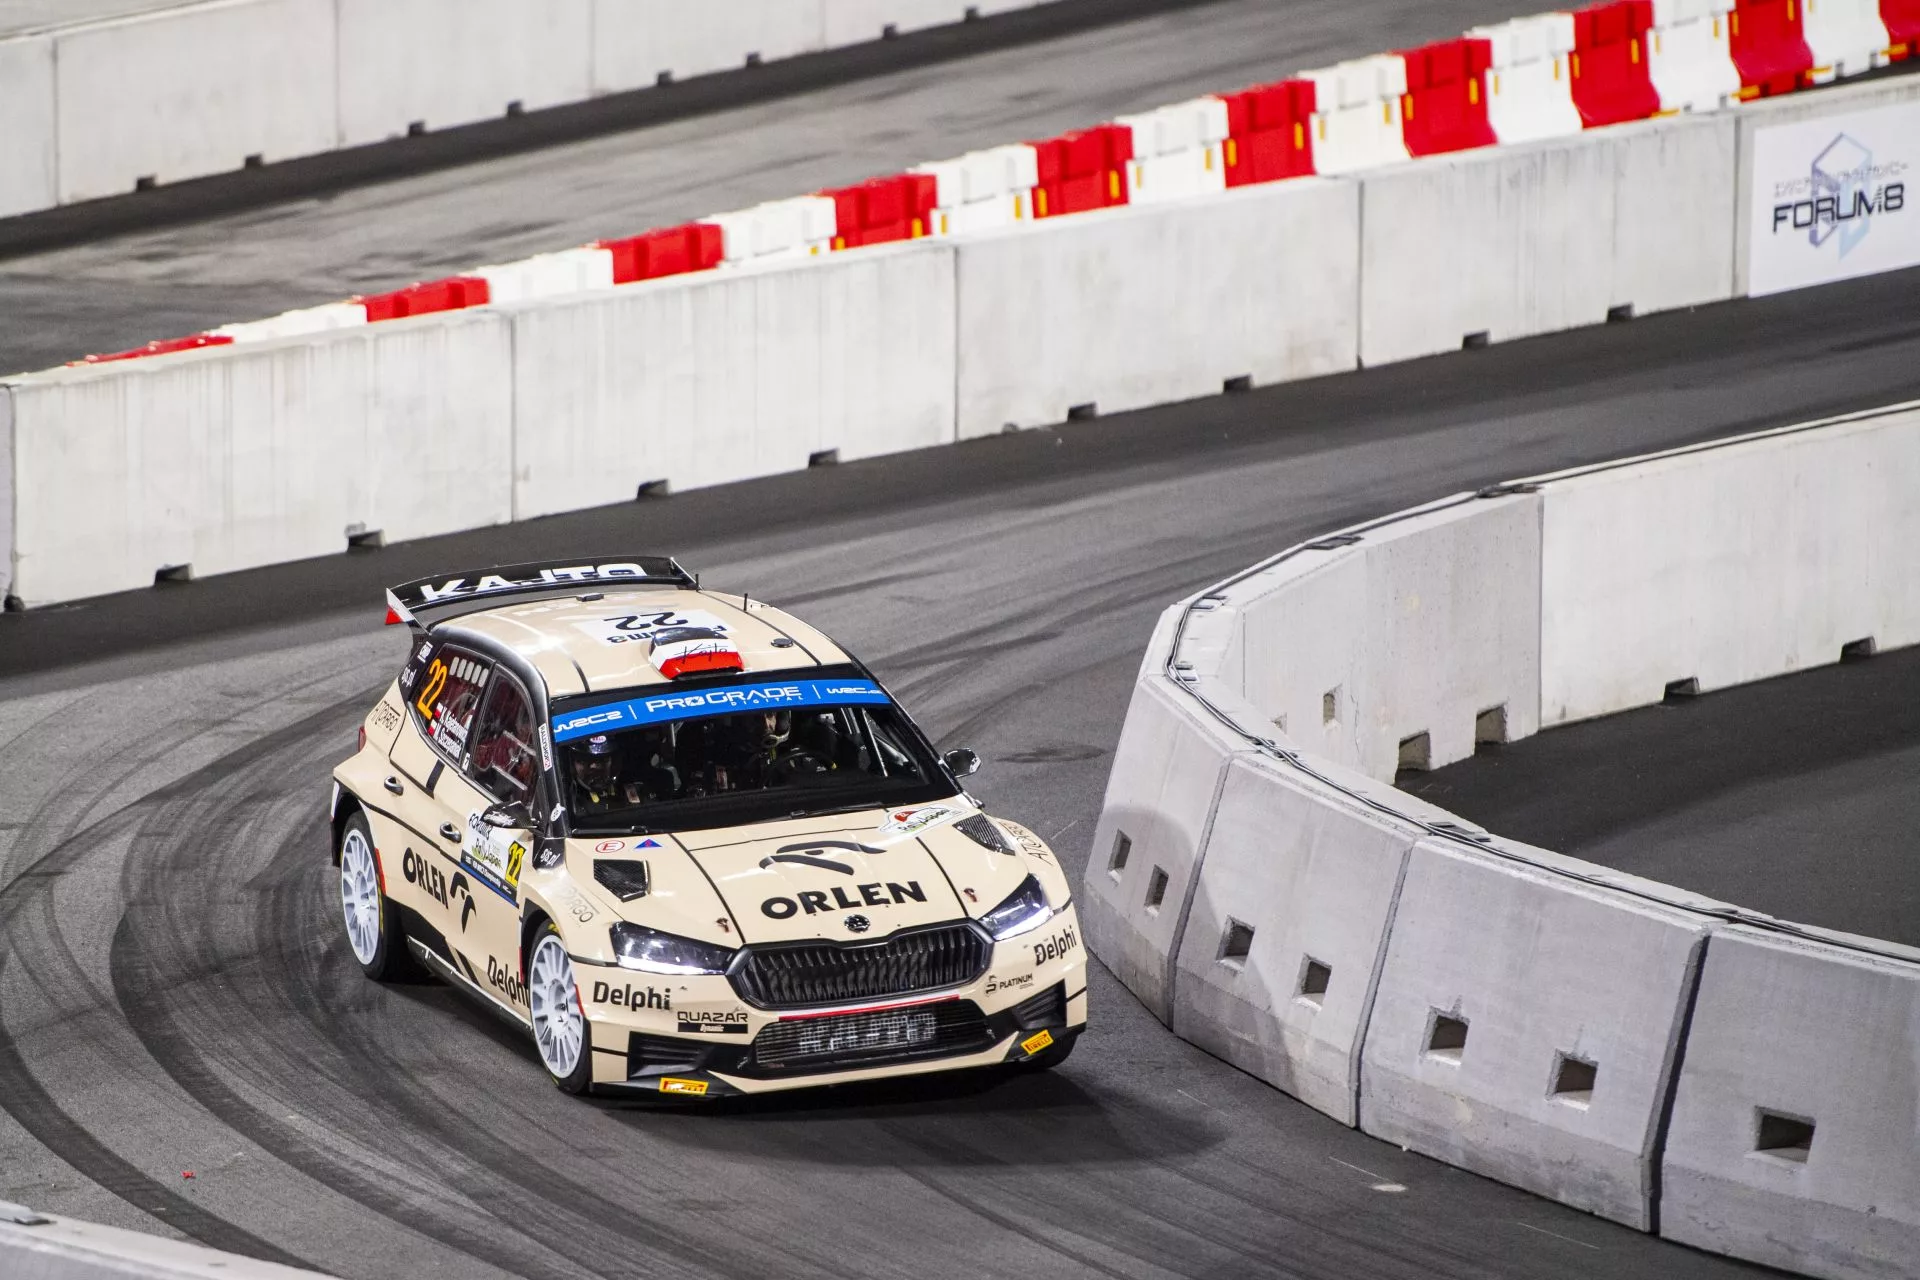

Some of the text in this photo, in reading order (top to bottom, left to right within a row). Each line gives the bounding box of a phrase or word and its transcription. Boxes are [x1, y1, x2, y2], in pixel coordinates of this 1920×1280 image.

[420, 563, 648, 600] KAJTO
[604, 612, 688, 630] 22
[417, 658, 448, 720] 22
[403, 847, 449, 910] ORLEN
[505, 843, 525, 888] 22
[761, 881, 928, 919] ORLEN
[1034, 925, 1077, 966] Delphi
[593, 980, 671, 1011] Delphi
[1000, 973, 1033, 990] PLATINUM
[677, 1011, 748, 1024] QUAZAR
